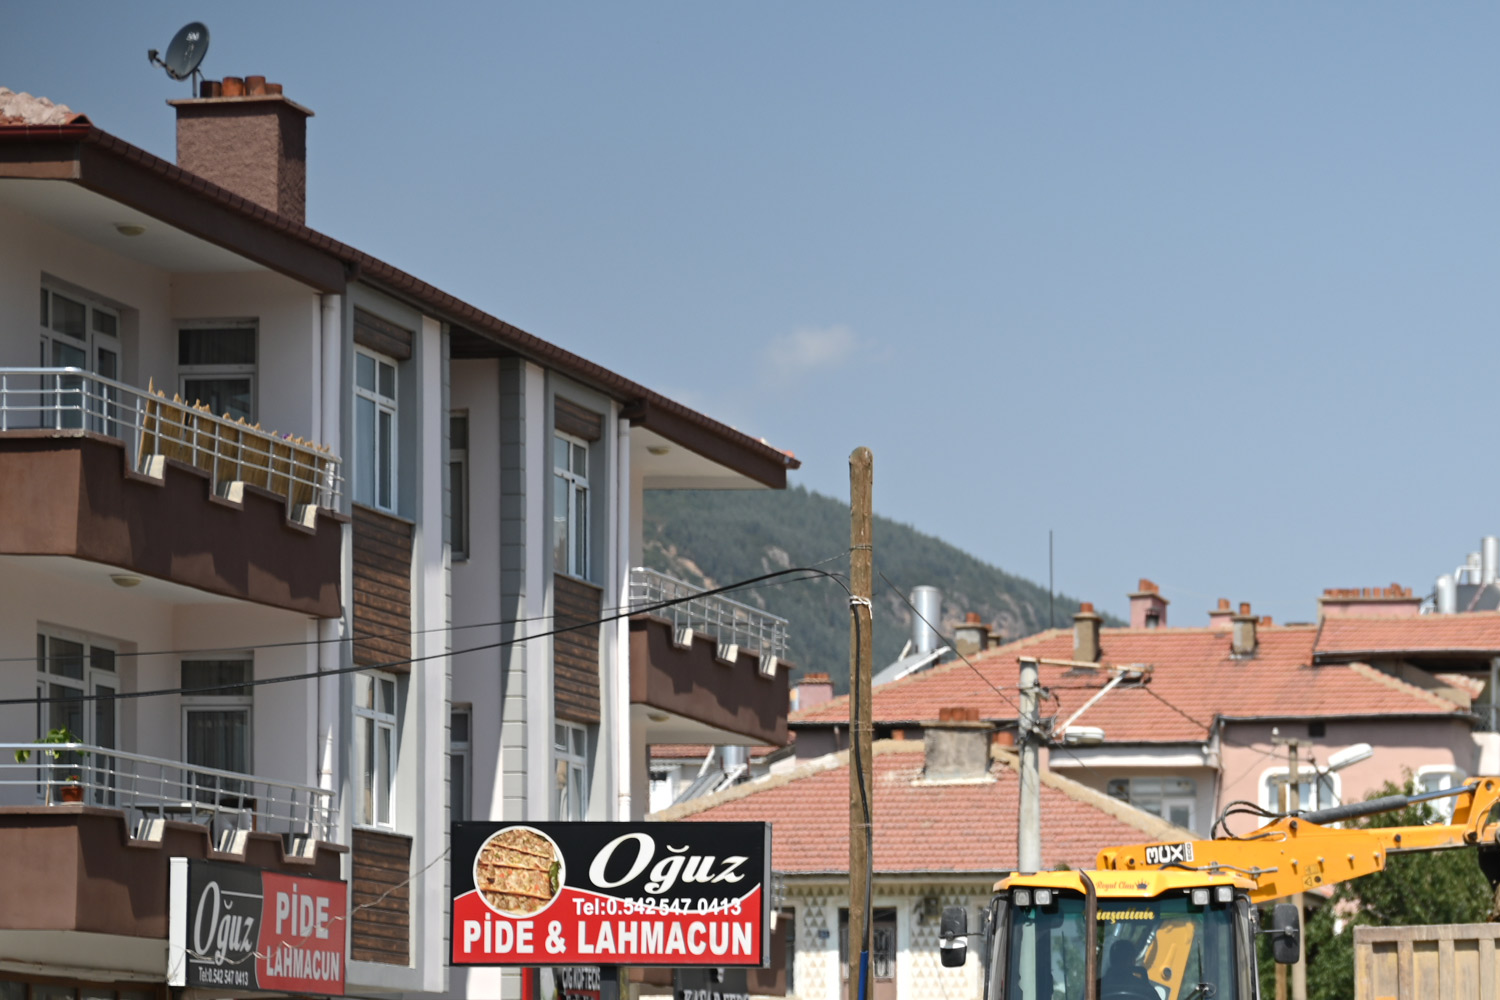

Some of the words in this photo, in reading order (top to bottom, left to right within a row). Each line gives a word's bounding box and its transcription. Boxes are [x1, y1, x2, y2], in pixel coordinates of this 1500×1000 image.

[588, 832, 749, 895] Oğuz
[193, 881, 254, 966] Oğuz
[275, 882, 329, 939] PİDE
[697, 898, 742, 916] 0413
[1096, 907, 1155, 924] aşallah
[463, 912, 534, 954] PİDE
[544, 920, 566, 954] &
[578, 920, 752, 955] LAHMACUN
[224, 970, 234, 985] 547
[235, 972, 249, 986] 0413
[266, 945, 340, 981] LAHMACUN
